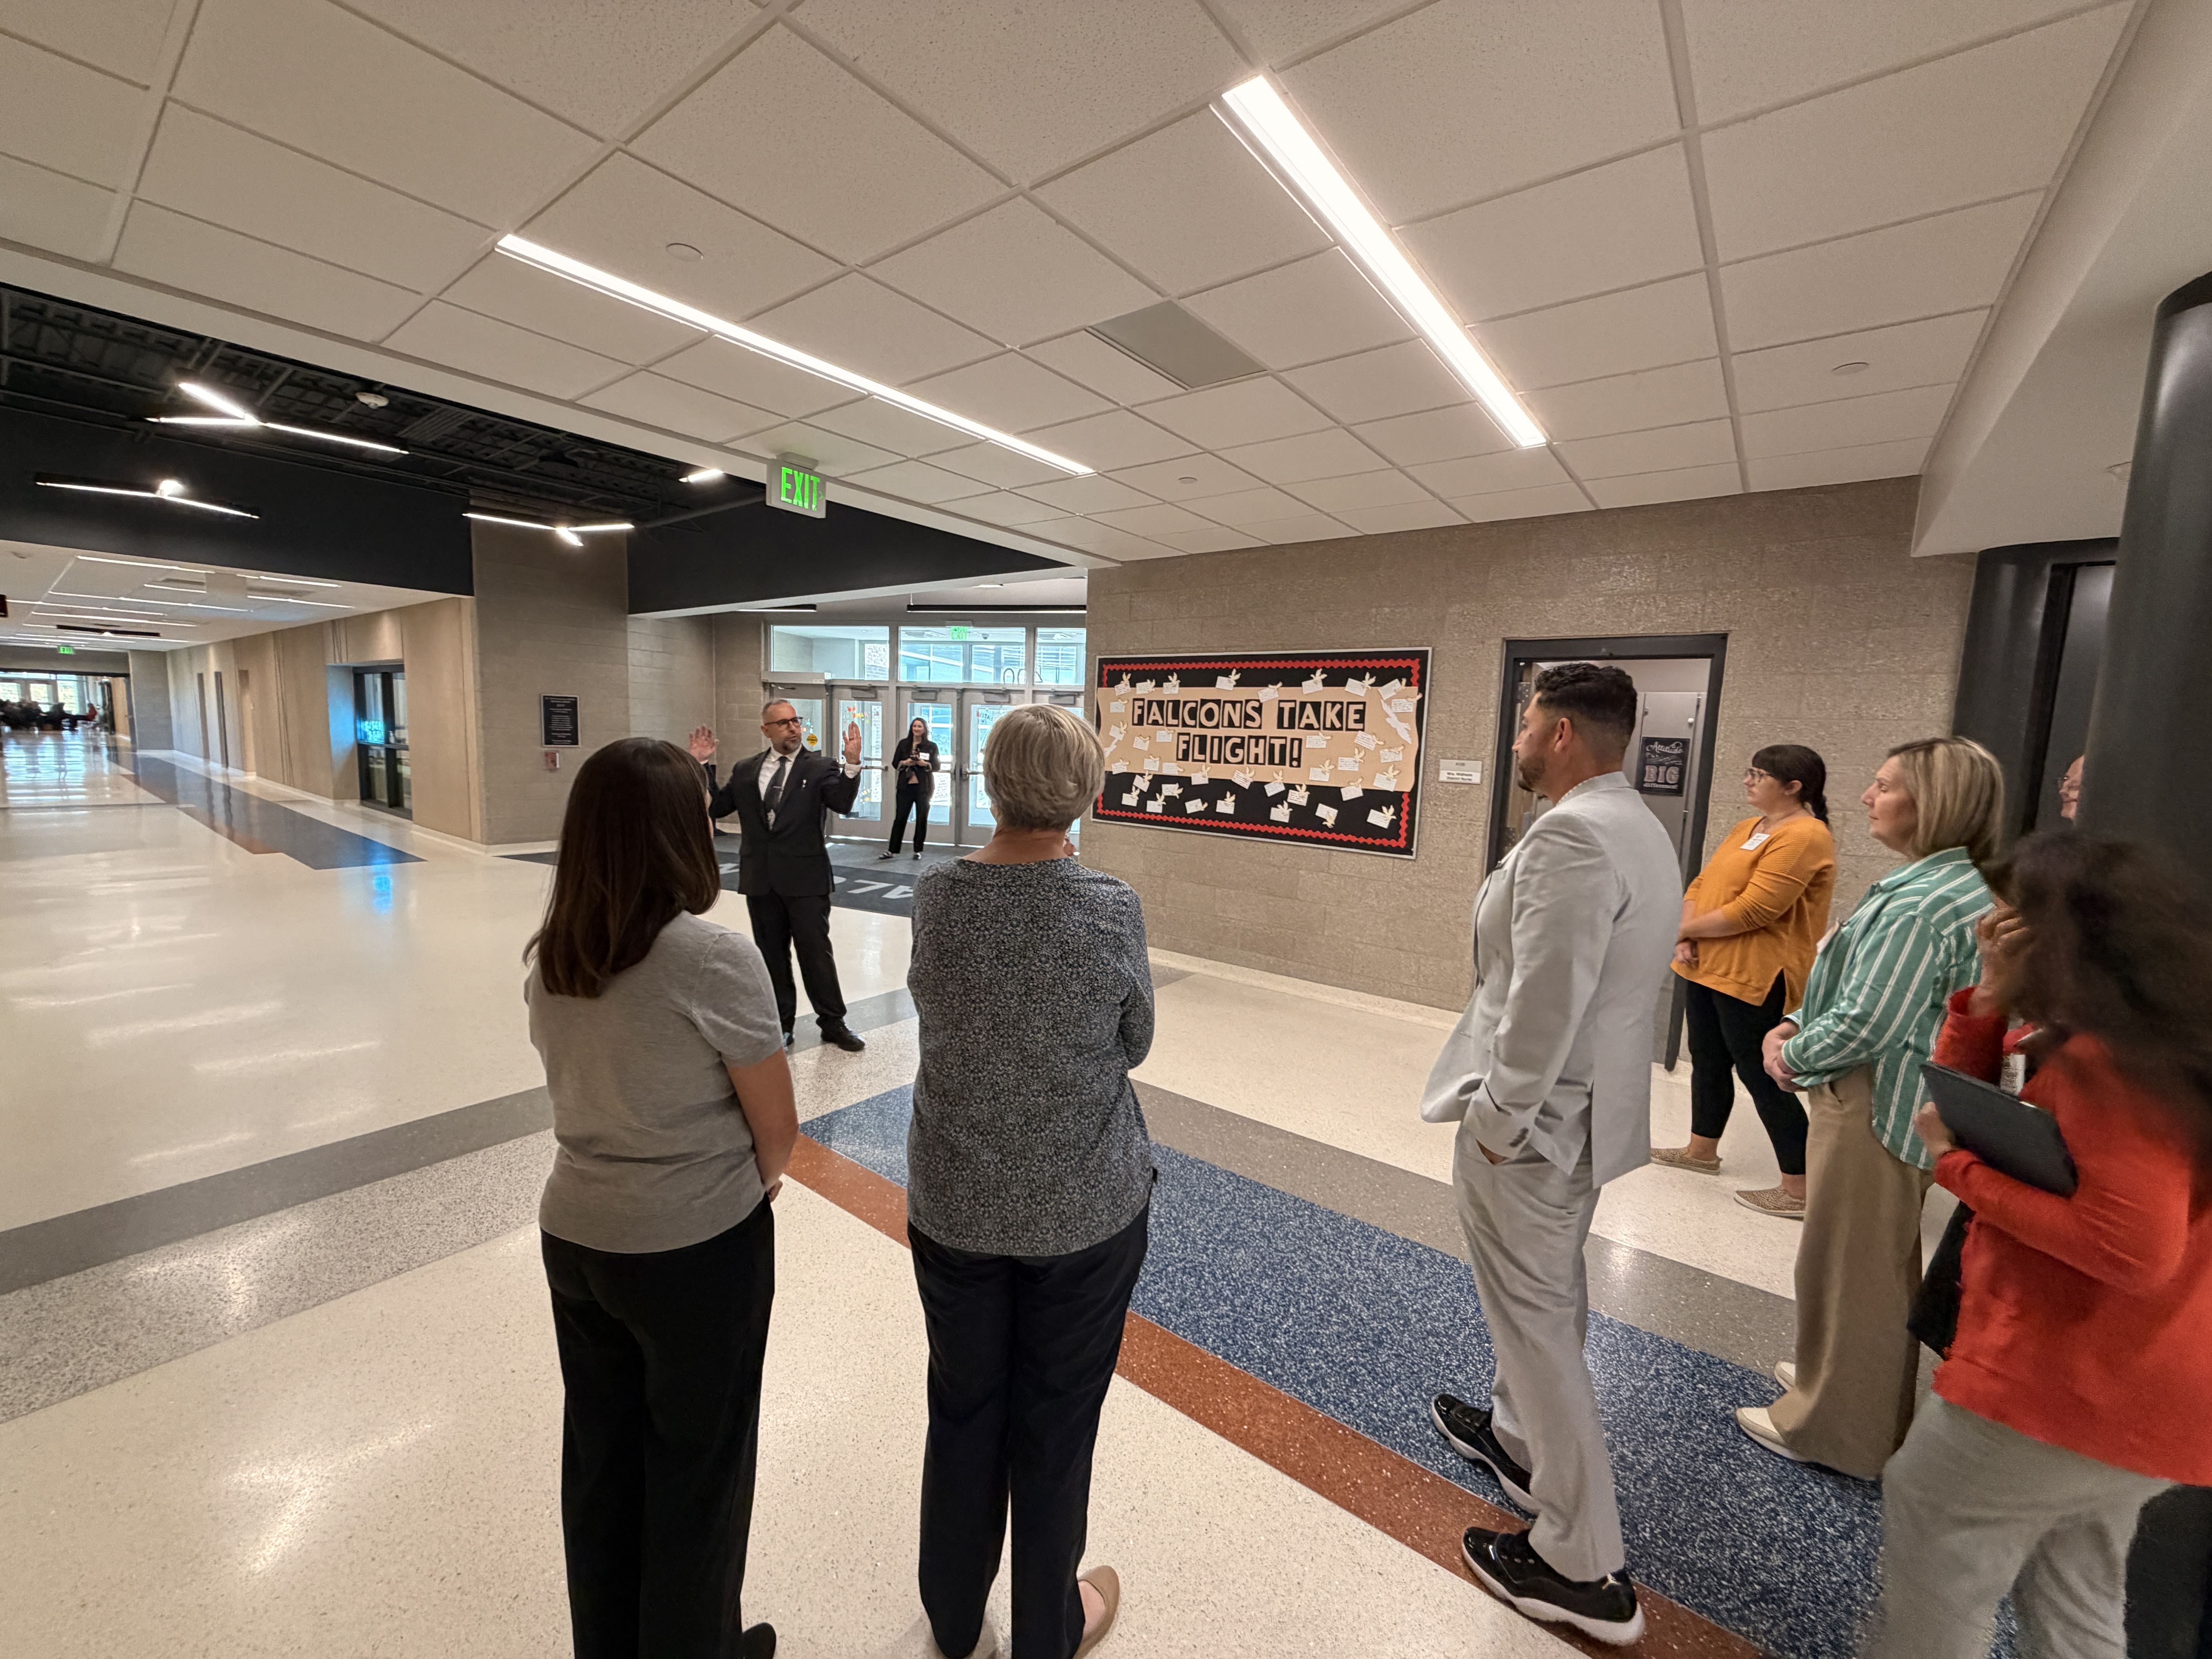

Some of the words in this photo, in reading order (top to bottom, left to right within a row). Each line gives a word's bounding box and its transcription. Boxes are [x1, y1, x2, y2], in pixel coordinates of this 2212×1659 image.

[781, 467, 820, 511] EXIT
[1133, 701, 1261, 728] FALCONS
[1279, 702, 1364, 729] TAKE
[1178, 735, 1299, 767] FLIGHT!
[1644, 765, 1680, 784] BIG
